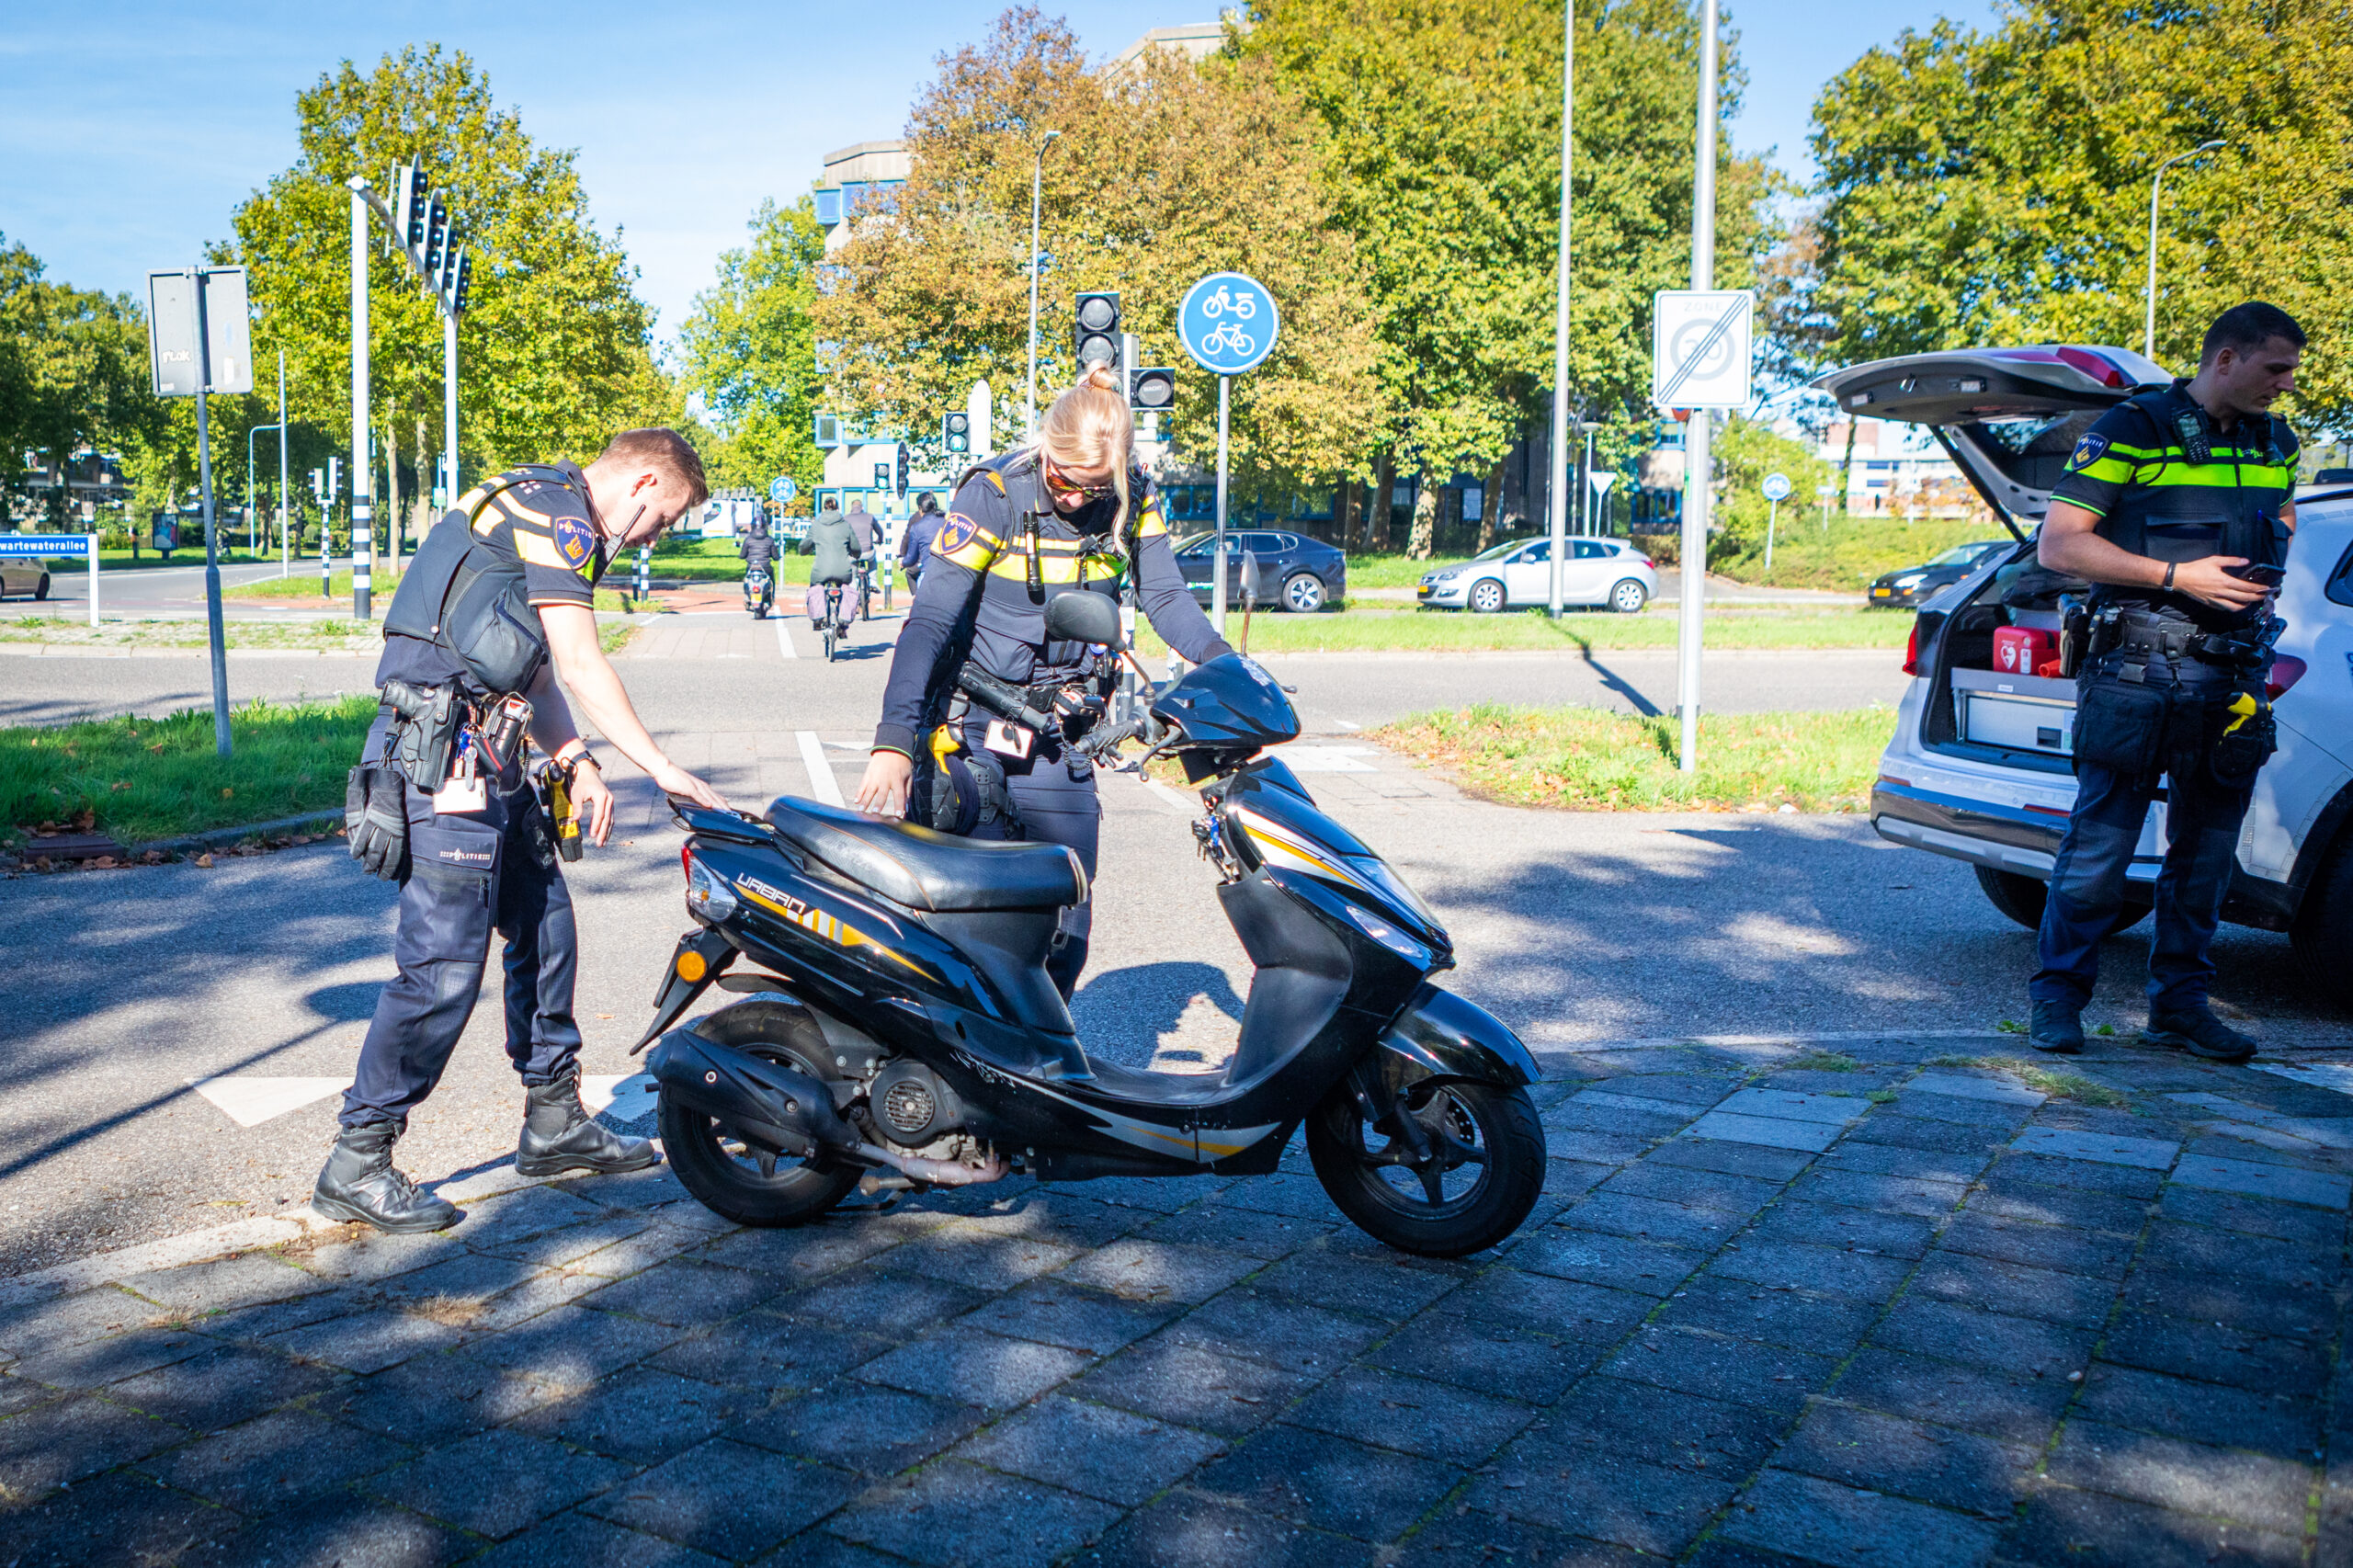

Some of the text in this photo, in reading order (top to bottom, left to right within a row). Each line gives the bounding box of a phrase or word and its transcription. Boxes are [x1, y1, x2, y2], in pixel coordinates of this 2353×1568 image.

[1683, 301, 1722, 312] ZONE
[1683, 337, 1722, 360] 30
[2080, 437, 2104, 448] POLITIE
[559, 520, 592, 539] POLITIE
[949, 517, 973, 532] POLITIE
[449, 848, 483, 861] POLITIE
[736, 872, 807, 915] URBAN
